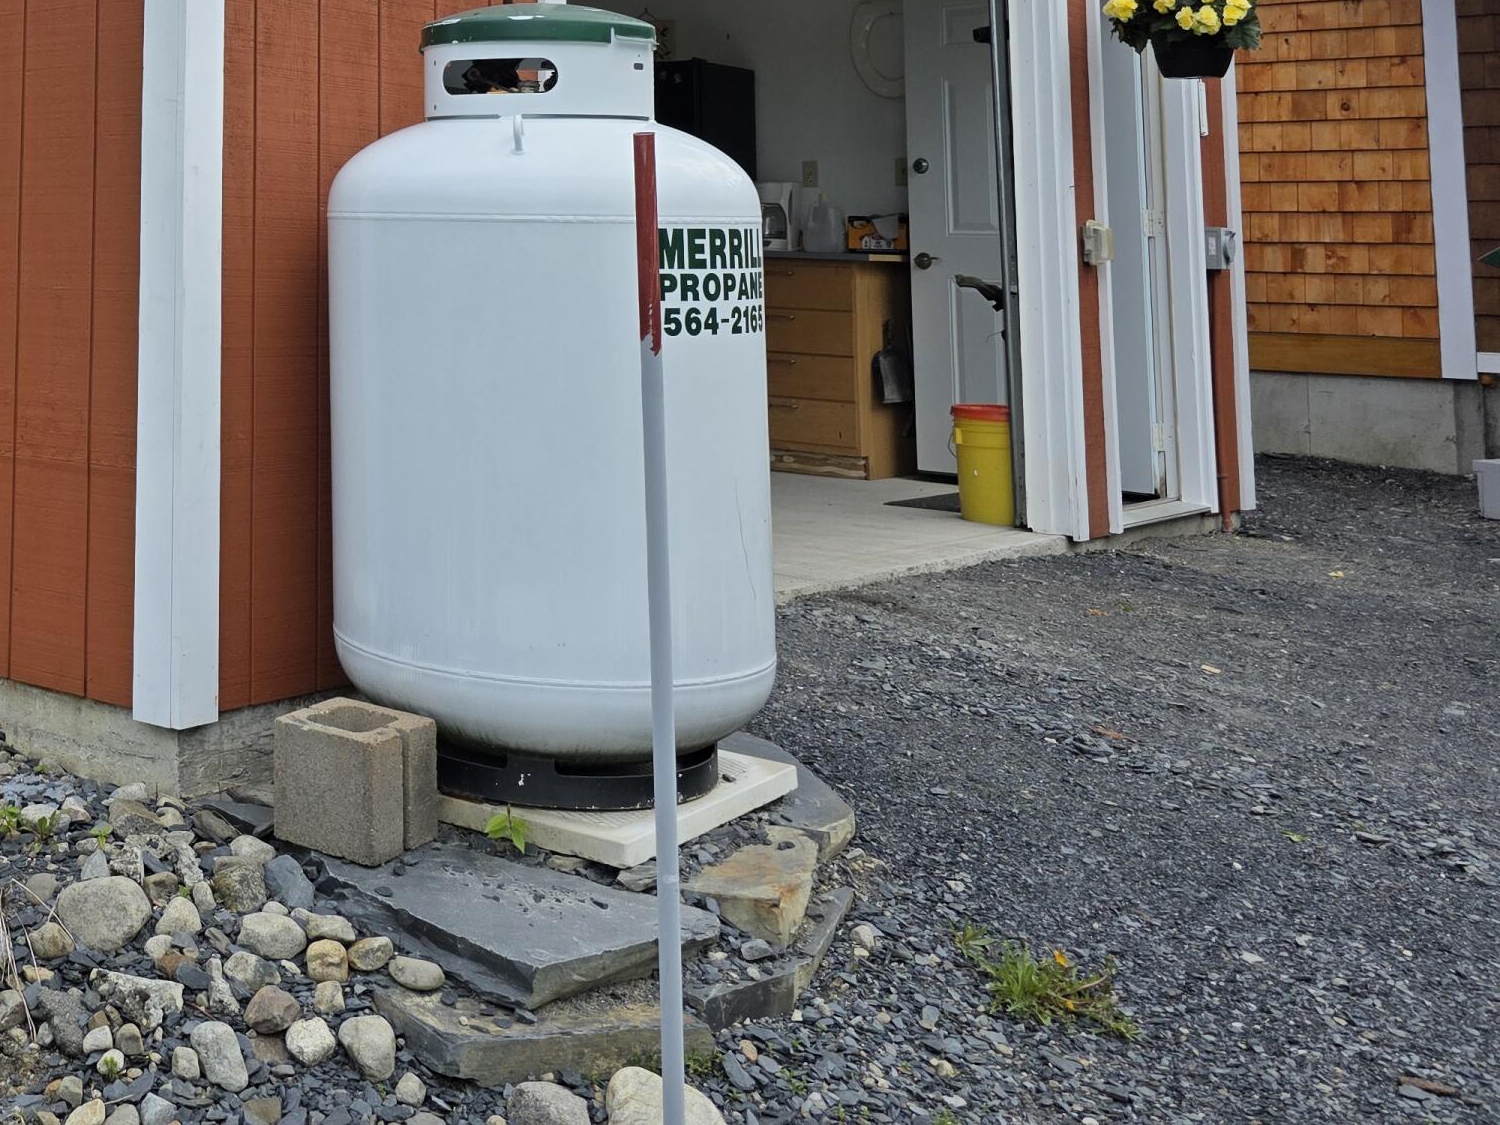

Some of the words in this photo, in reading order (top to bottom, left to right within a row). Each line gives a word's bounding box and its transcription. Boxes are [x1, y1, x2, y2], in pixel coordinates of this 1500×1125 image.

[658, 228, 761, 269] MERRILL
[660, 272, 762, 301] PROPANE
[664, 305, 762, 336] 564-2165
